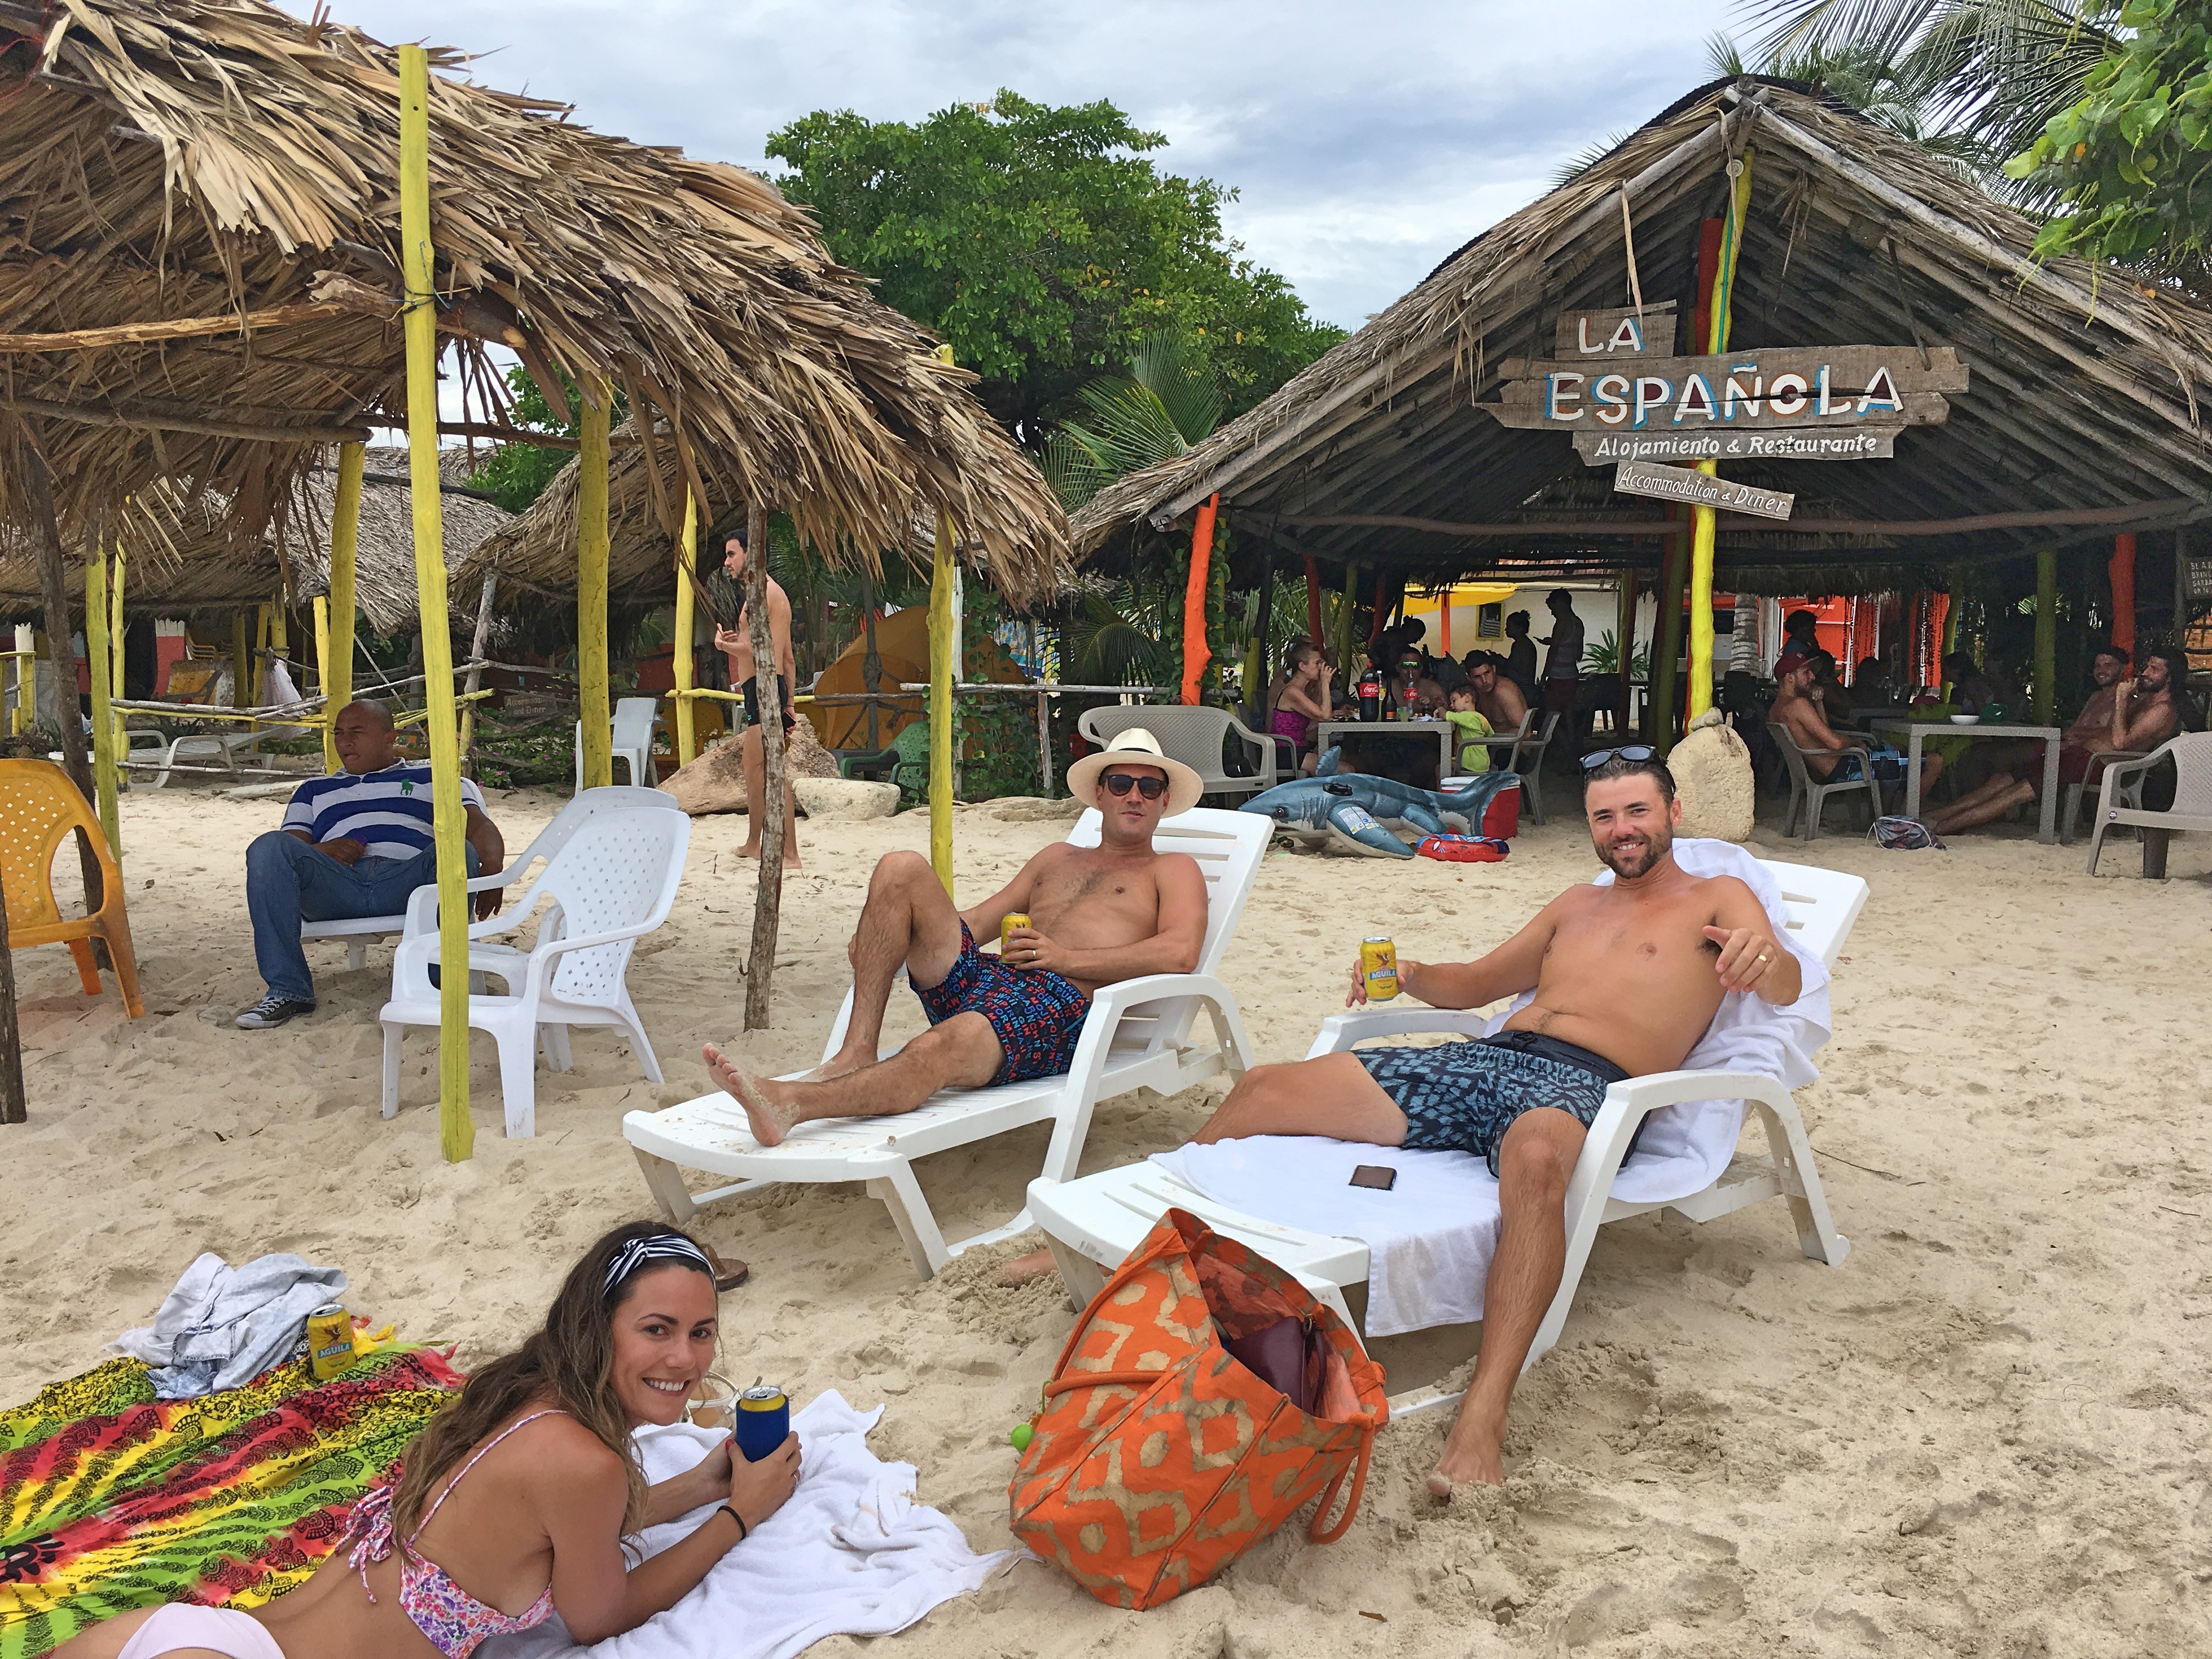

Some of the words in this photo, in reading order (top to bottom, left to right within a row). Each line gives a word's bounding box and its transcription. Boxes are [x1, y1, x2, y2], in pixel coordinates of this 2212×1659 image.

[1578, 317, 1645, 354] LA
[1544, 362, 1904, 431] ESPAÑOLA
[1594, 437, 1720, 460] Alojamiento
[1726, 438, 1742, 454] &
[1747, 433, 1877, 454] Restaurante
[1617, 466, 1718, 500] Accommodation
[1721, 492, 1730, 500] &
[1734, 487, 1787, 512] Diner
[1372, 970, 1396, 979] AGUILA
[320, 1343, 350, 1357] AGUILA
